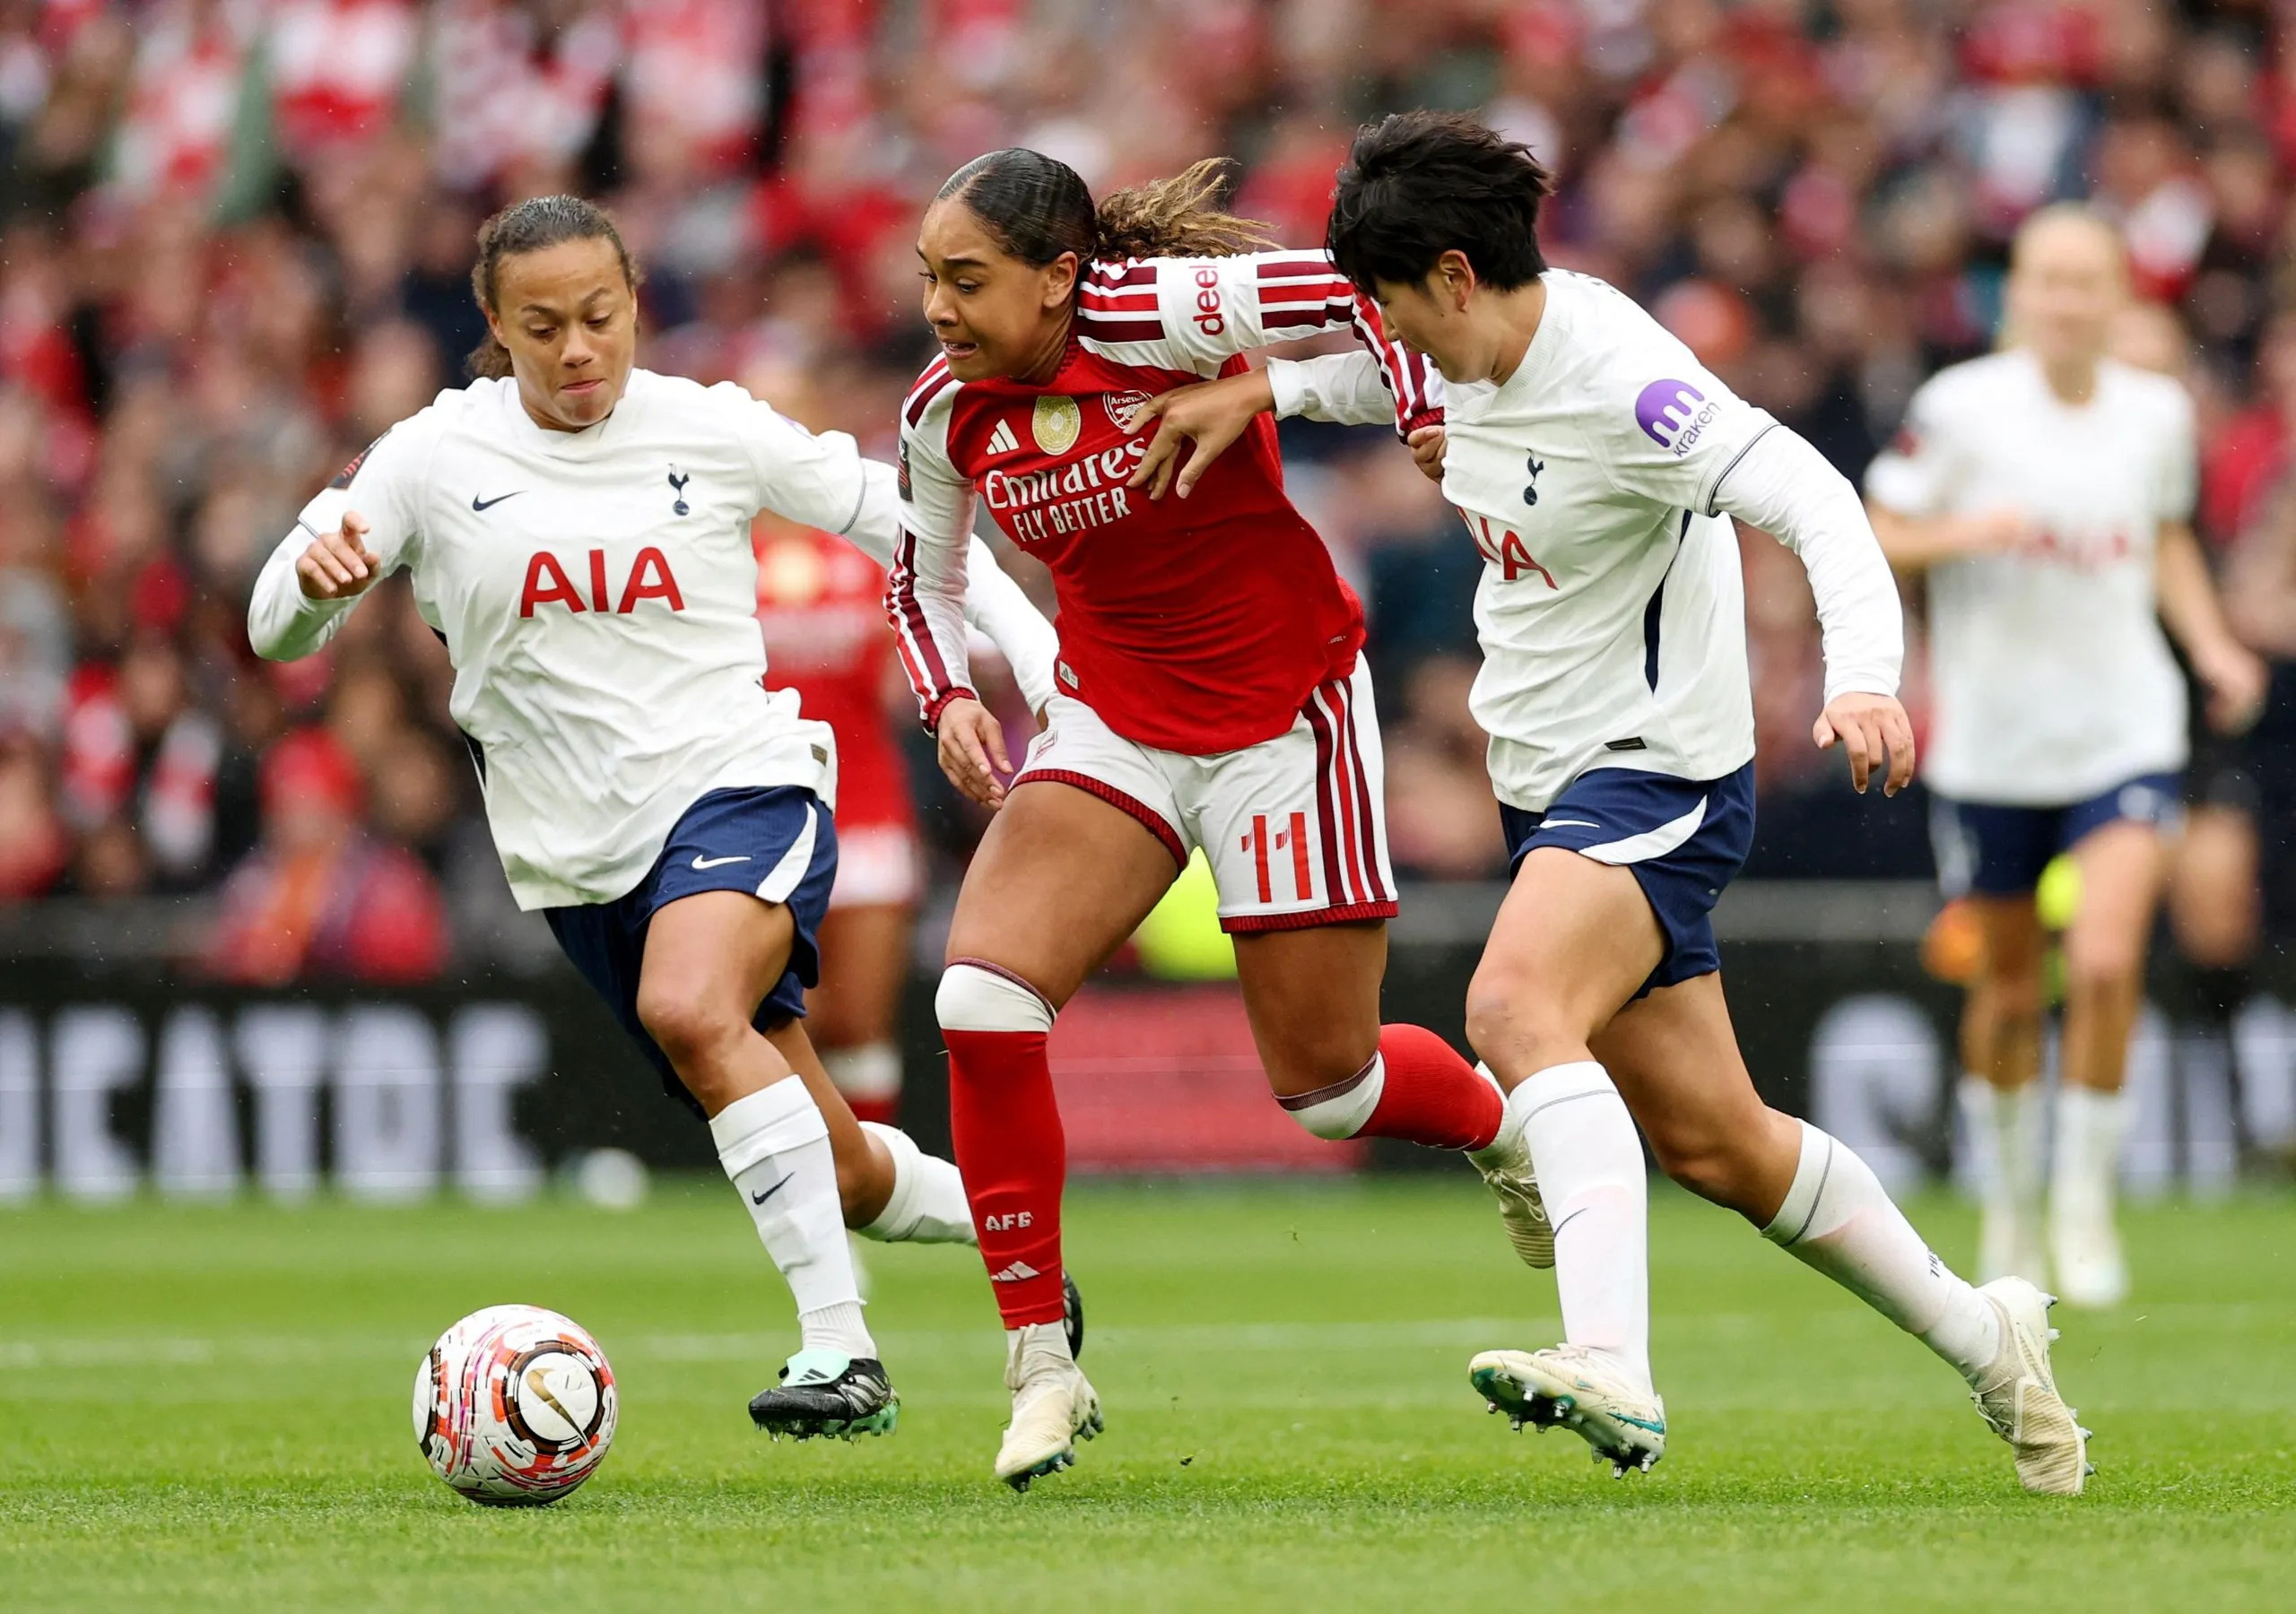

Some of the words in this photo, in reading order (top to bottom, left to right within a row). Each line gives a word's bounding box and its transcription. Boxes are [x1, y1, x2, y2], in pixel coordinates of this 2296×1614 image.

[1188, 265, 1224, 336] deel
[1674, 402, 1722, 458] kraken
[985, 437, 1148, 509] Emirates
[1013, 508, 1048, 542] FLY
[1049, 486, 1132, 534] BETTER
[519, 546, 686, 619] AIA
[1240, 811, 1313, 904] 11
